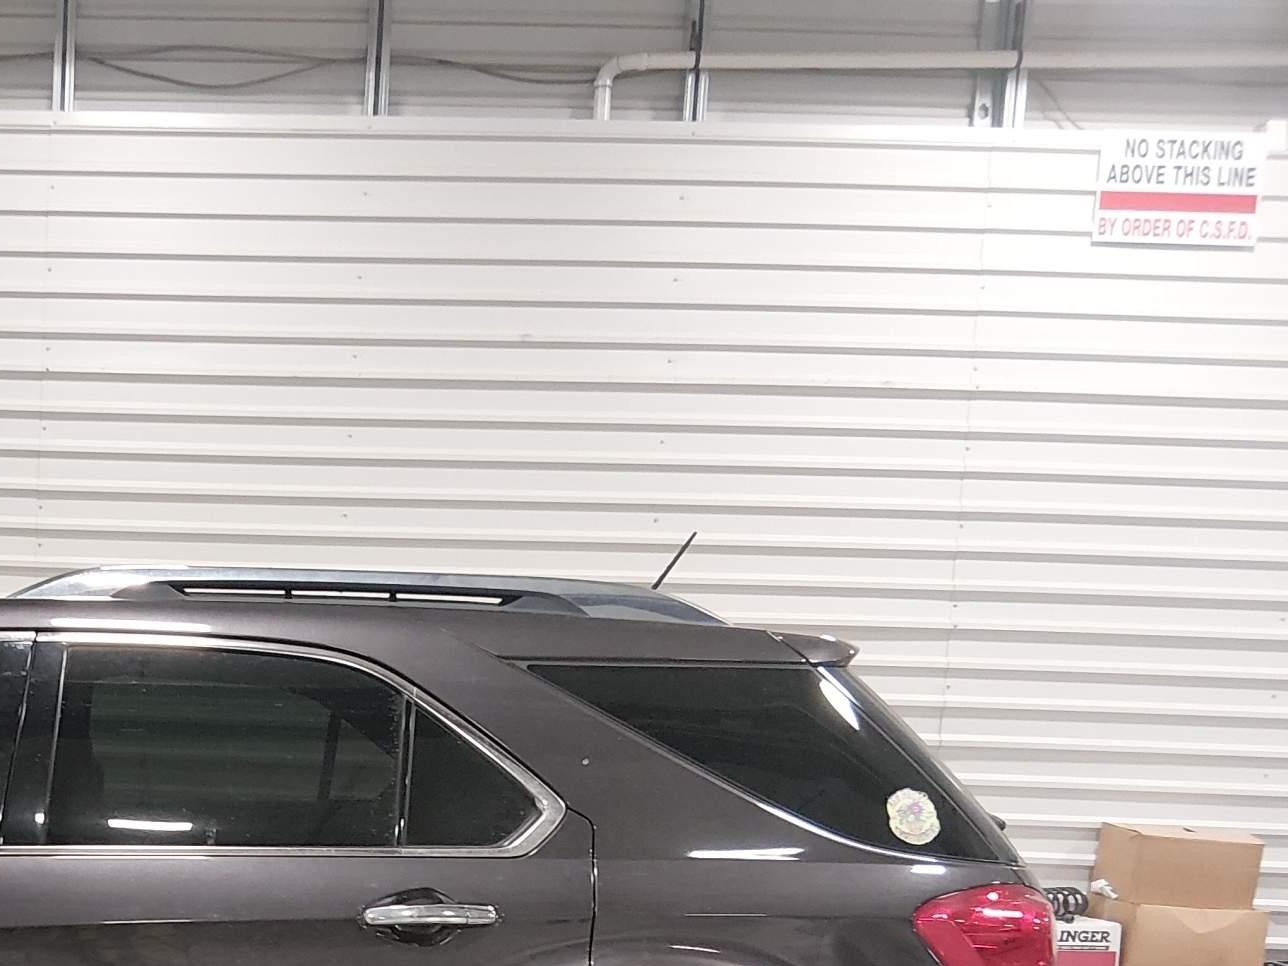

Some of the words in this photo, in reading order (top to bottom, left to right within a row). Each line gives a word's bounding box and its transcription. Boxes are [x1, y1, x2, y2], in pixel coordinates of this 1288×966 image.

[1124, 138, 1149, 158] NO
[1155, 139, 1244, 160] STACKING
[1106, 164, 1166, 185] ABOVE
[1173, 166, 1211, 187] THIS
[1217, 167, 1257, 188] LINE
[1098, 217, 1118, 236] BY
[1121, 218, 1172, 238] ORDER
[1176, 219, 1196, 238] OF
[1199, 220, 1252, 240] C.S.F.D.
